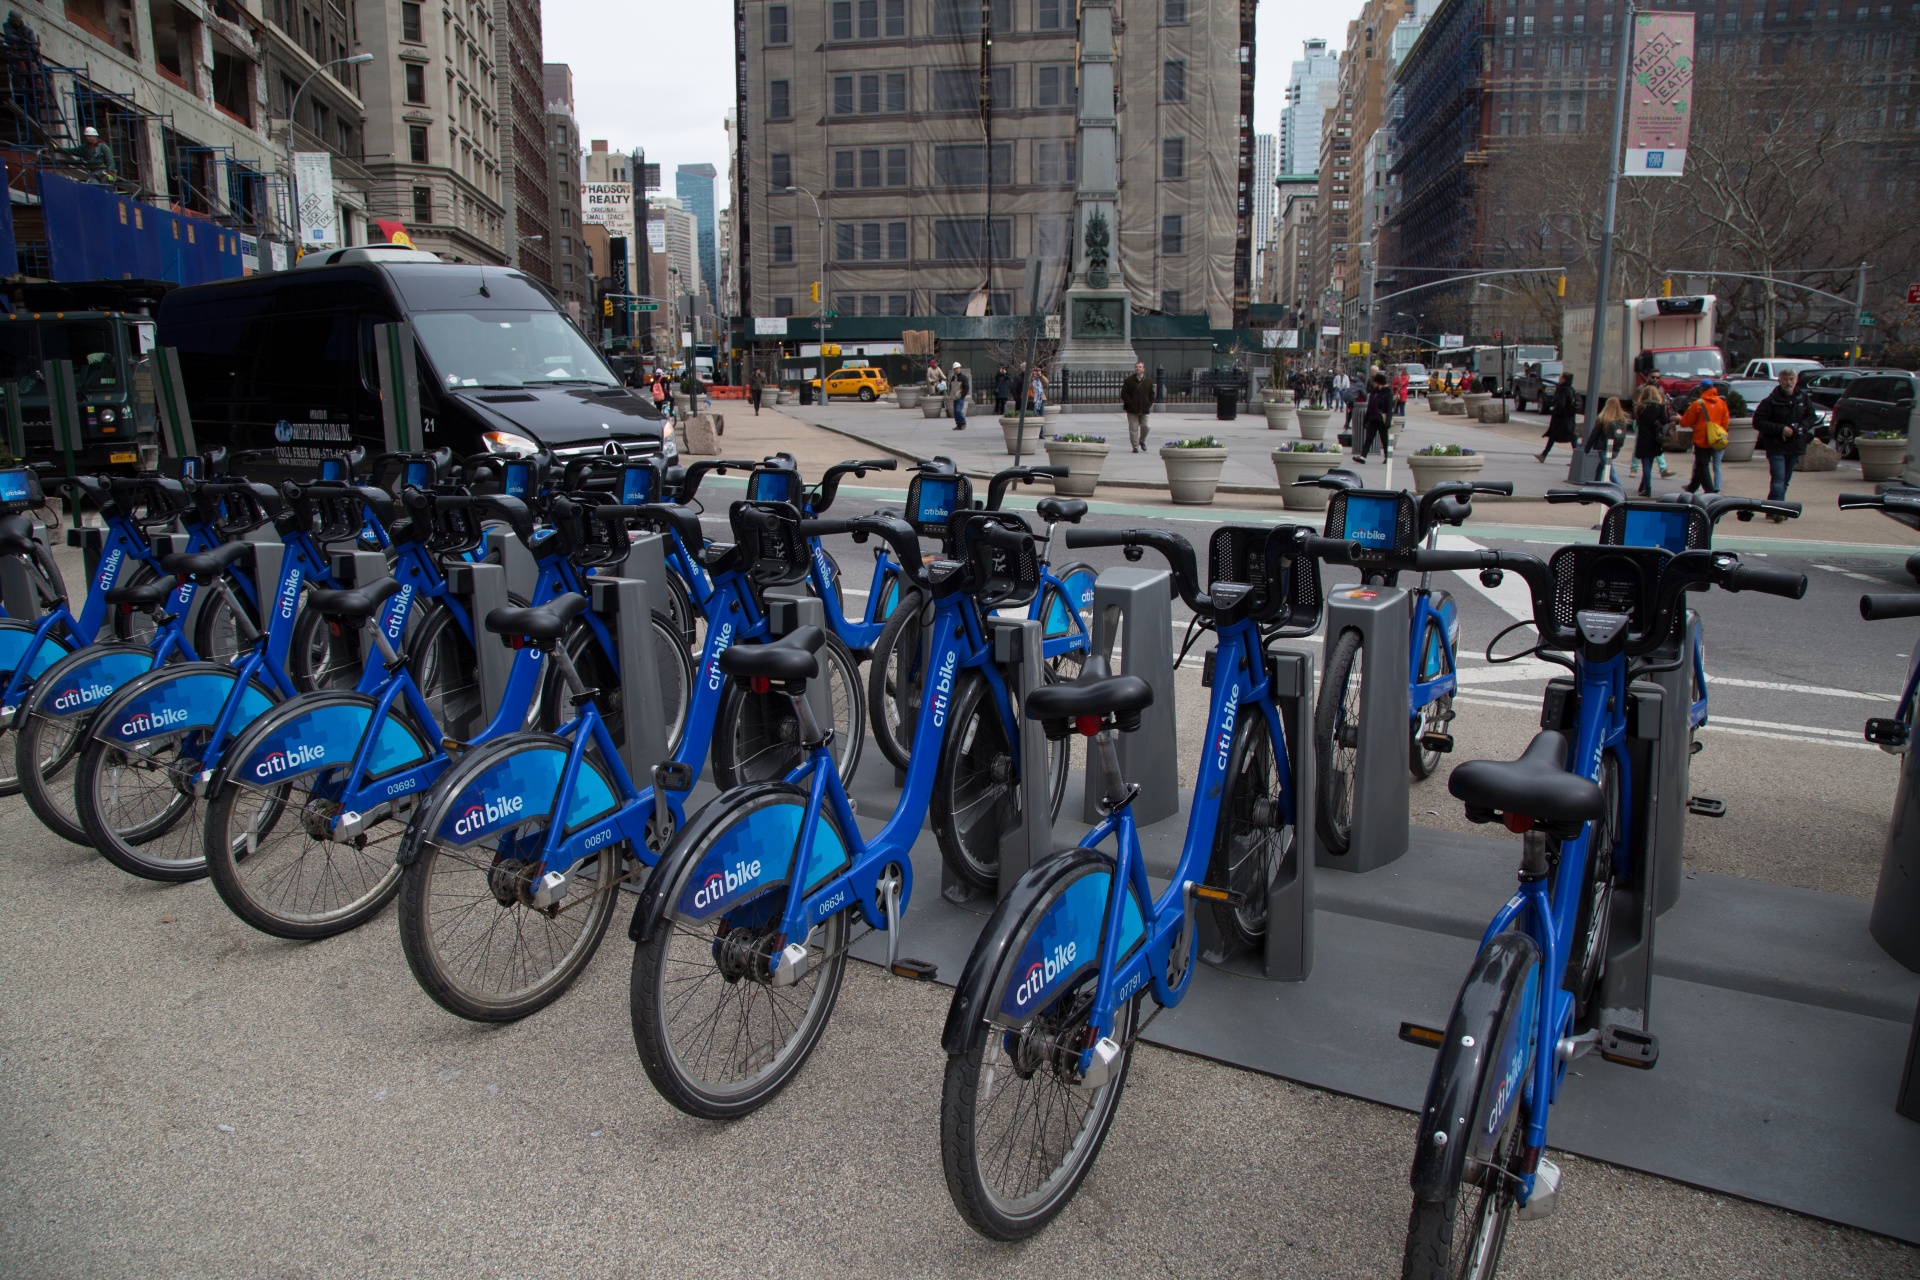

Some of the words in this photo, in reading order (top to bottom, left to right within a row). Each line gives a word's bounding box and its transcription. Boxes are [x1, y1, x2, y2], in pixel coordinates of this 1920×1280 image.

[1634, 41, 1669, 72] MAD.
[1649, 65, 1671, 86] SQ.
[1658, 66, 1691, 98] EATS
[588, 184, 630, 194] HADSON
[589, 195, 630, 204] REALTY
[300, 199, 318, 217] MAD.
[424, 418, 435, 433] 21
[275, 446, 292, 458] TOLL
[292, 447, 309, 458] FREE
[924, 508, 935, 516] citi
[935, 508, 948, 516] bike
[1351, 528, 1366, 539] citi
[1367, 530, 1385, 540] bike
[103, 549, 121, 573] bike
[97, 571, 114, 591] citi
[284, 568, 300, 593] bike
[820, 562, 831, 589] bike
[177, 583, 193, 603] citi
[279, 592, 294, 619] citi
[392, 583, 412, 616] bike
[386, 613, 403, 638] citi
[936, 650, 956, 693] bike
[54, 689, 81, 710] citi
[80, 684, 113, 703] bike
[931, 691, 948, 728] citi
[1221, 683, 1239, 732] bike
[121, 713, 151, 735] citi
[151, 707, 188, 729] bike
[256, 751, 286, 777] citi
[286, 744, 325, 768] bike
[1215, 732, 1231, 771] citi
[387, 778, 416, 795] 03693
[454, 806, 486, 836] citi
[485, 795, 523, 823] bike
[584, 829, 612, 849] 00870
[694, 873, 724, 909] citi
[724, 859, 762, 893] bike
[819, 891, 845, 915] 06634
[1016, 962, 1044, 1006] citi
[1044, 941, 1077, 983] bike
[1120, 971, 1141, 1001] 07791
[1488, 1080, 1506, 1134] citi
[1505, 1048, 1523, 1101] bike
